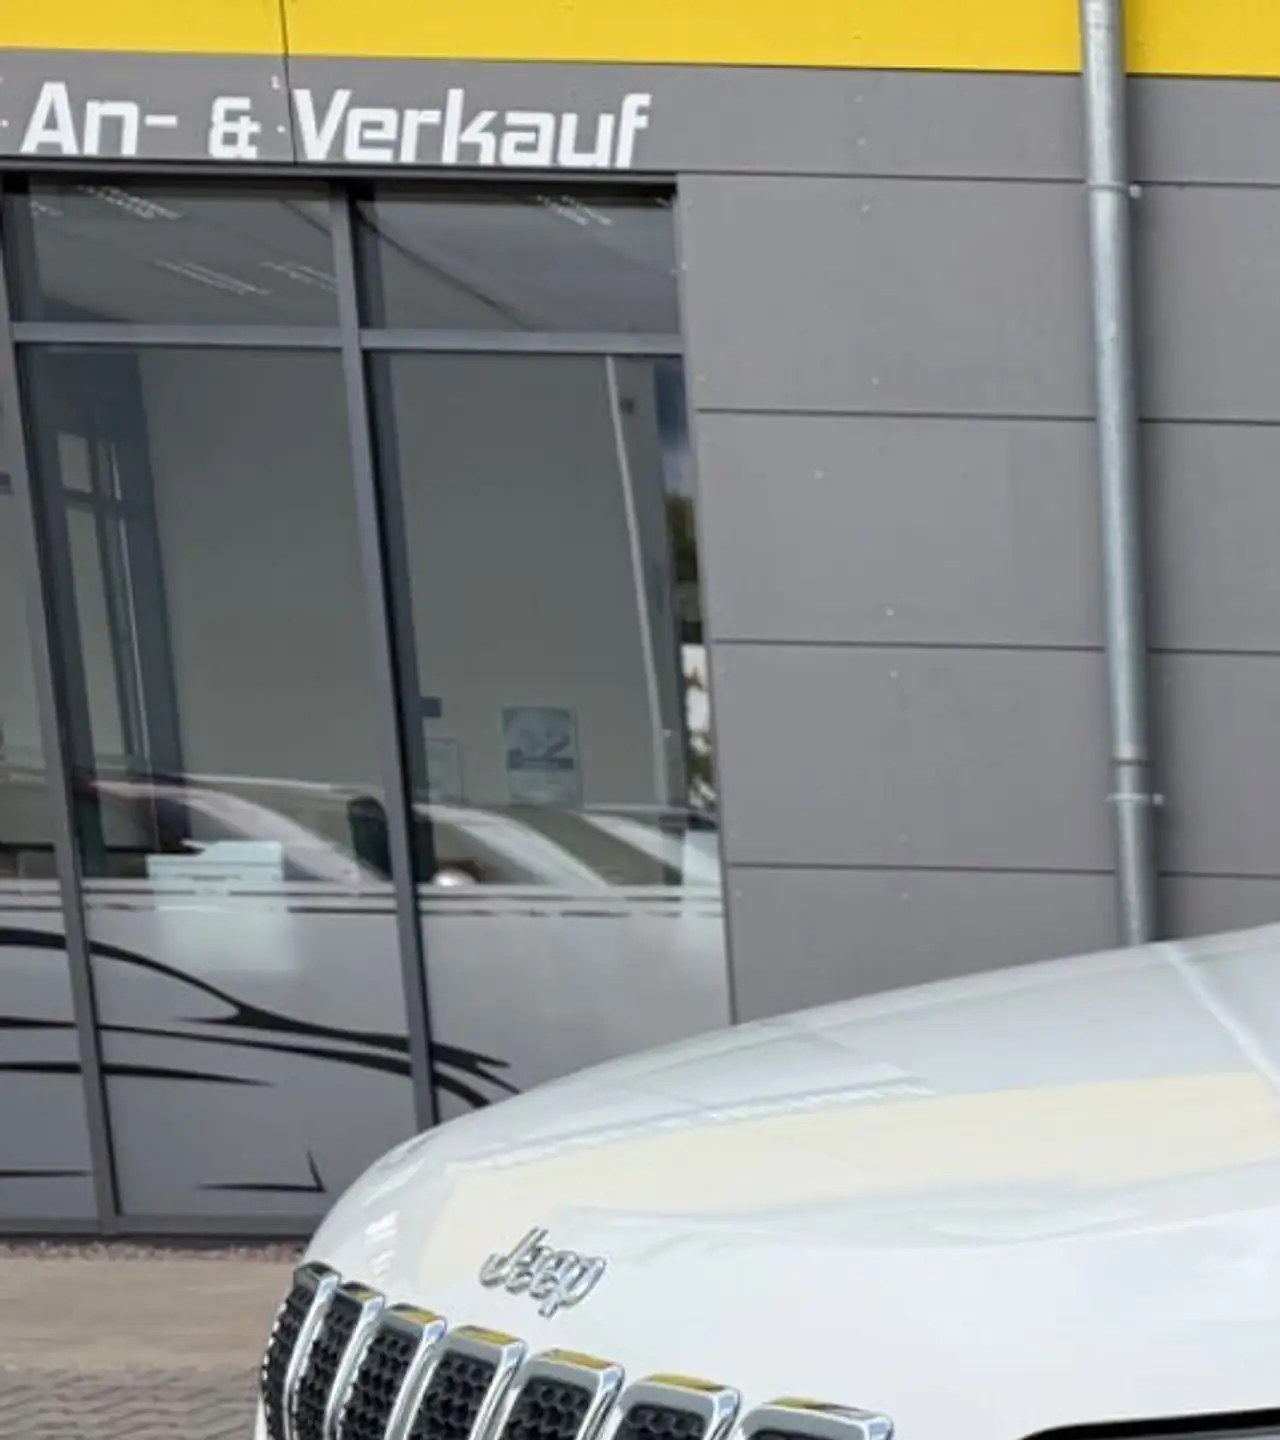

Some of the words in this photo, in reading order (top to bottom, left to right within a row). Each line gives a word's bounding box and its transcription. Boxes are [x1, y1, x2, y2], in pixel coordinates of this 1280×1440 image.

[20, 80, 178, 156] An-
[208, 95, 262, 161] &
[292, 88, 652, 168] Verkauf
[479, 1224, 608, 1319] Jeep
